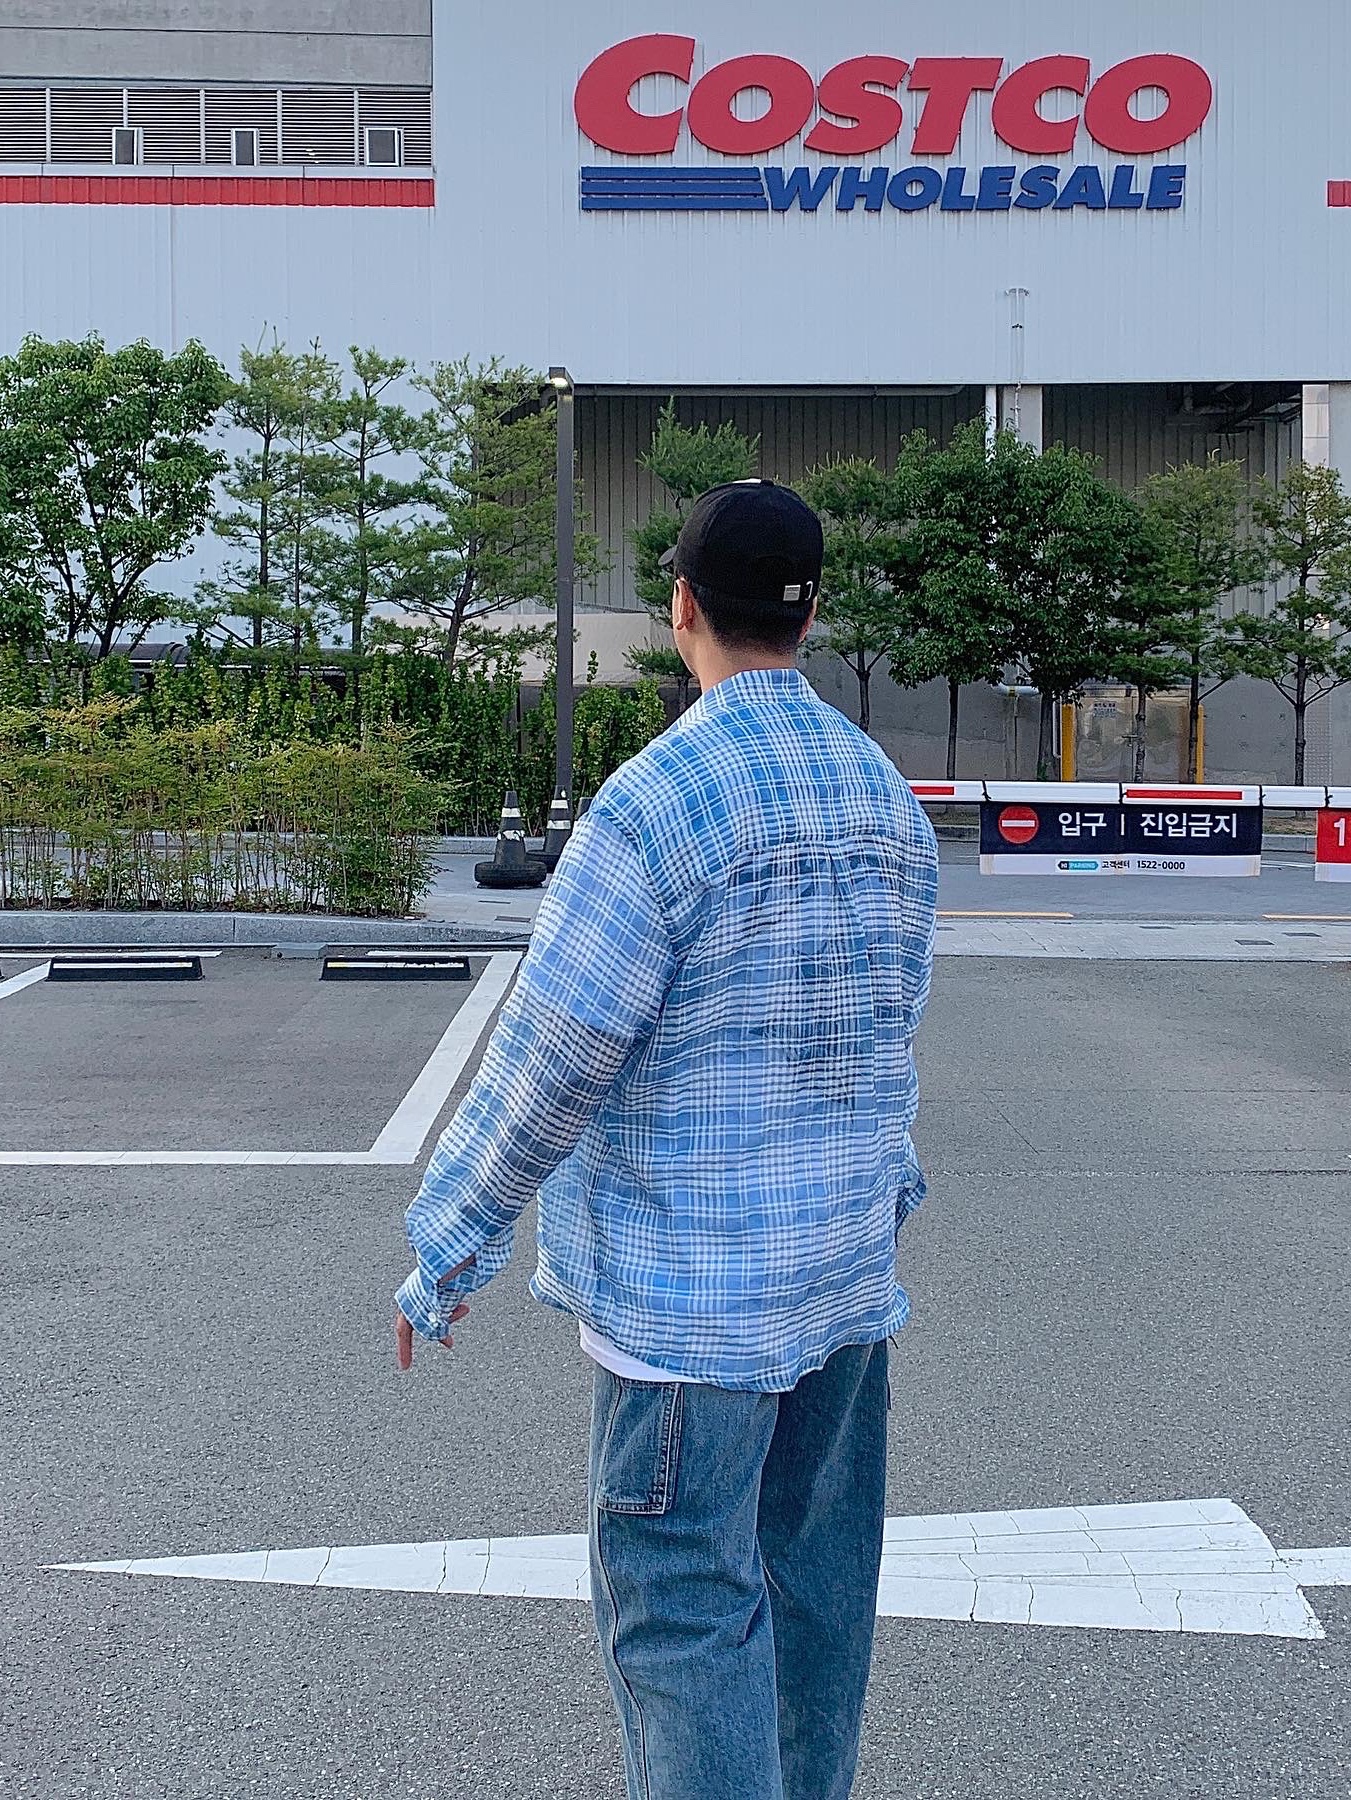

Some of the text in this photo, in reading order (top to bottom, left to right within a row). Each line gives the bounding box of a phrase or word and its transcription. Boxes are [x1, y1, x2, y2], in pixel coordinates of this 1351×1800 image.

[574, 34, 1213, 155] COSTCO
[763, 164, 1187, 211] WHOLESALE
[1058, 811, 1237, 838] 입구 진입금지
[1101, 860, 1186, 870] 고객센터 1522-0000
